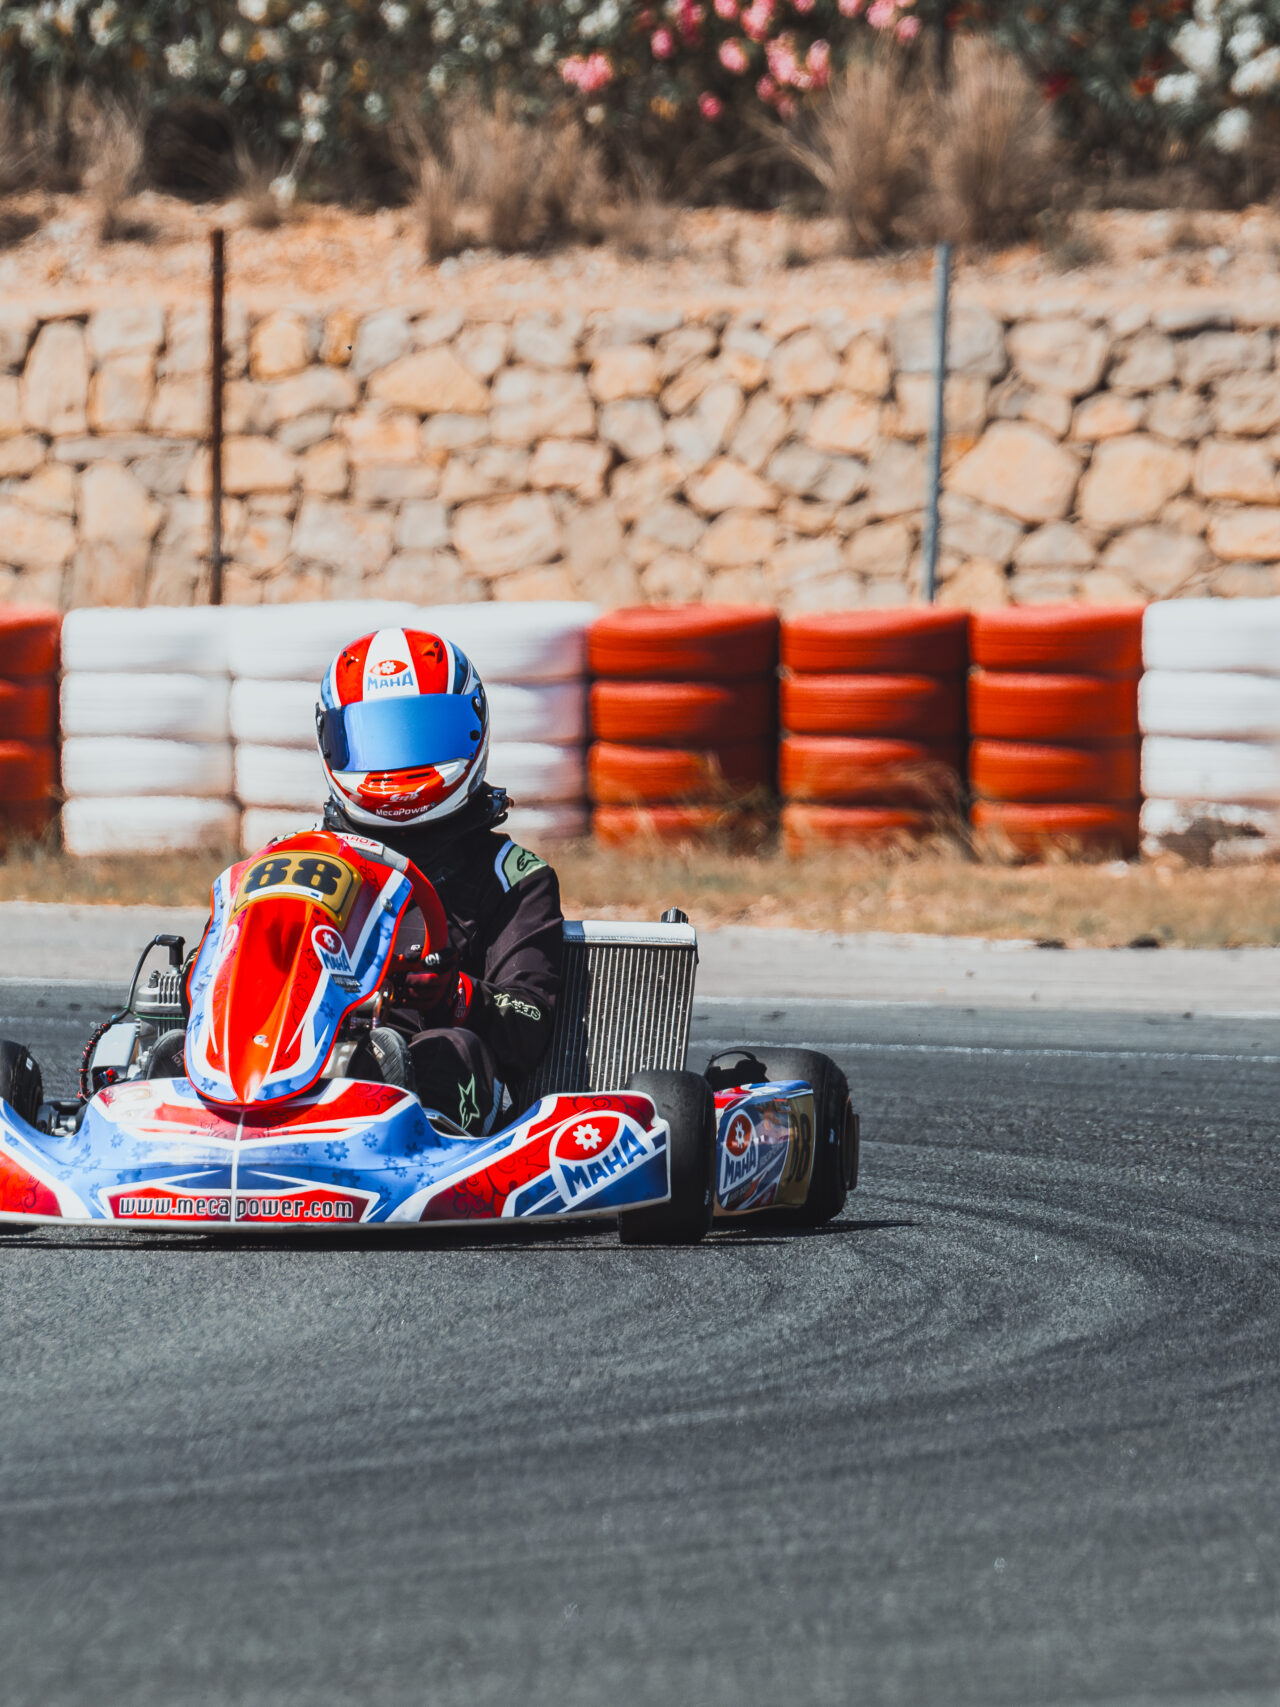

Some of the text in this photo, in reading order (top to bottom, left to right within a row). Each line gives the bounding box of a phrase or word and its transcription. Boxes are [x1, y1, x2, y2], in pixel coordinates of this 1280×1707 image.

[367, 671, 414, 691] MAHA
[375, 804, 429, 817] MecaPower
[244, 858, 342, 896] 88
[319, 947, 352, 972] MAHA
[559, 1124, 648, 1198] MAHA
[722, 1147, 756, 1189] MAHA
[119, 1197, 354, 1219] www.mecapower.com
